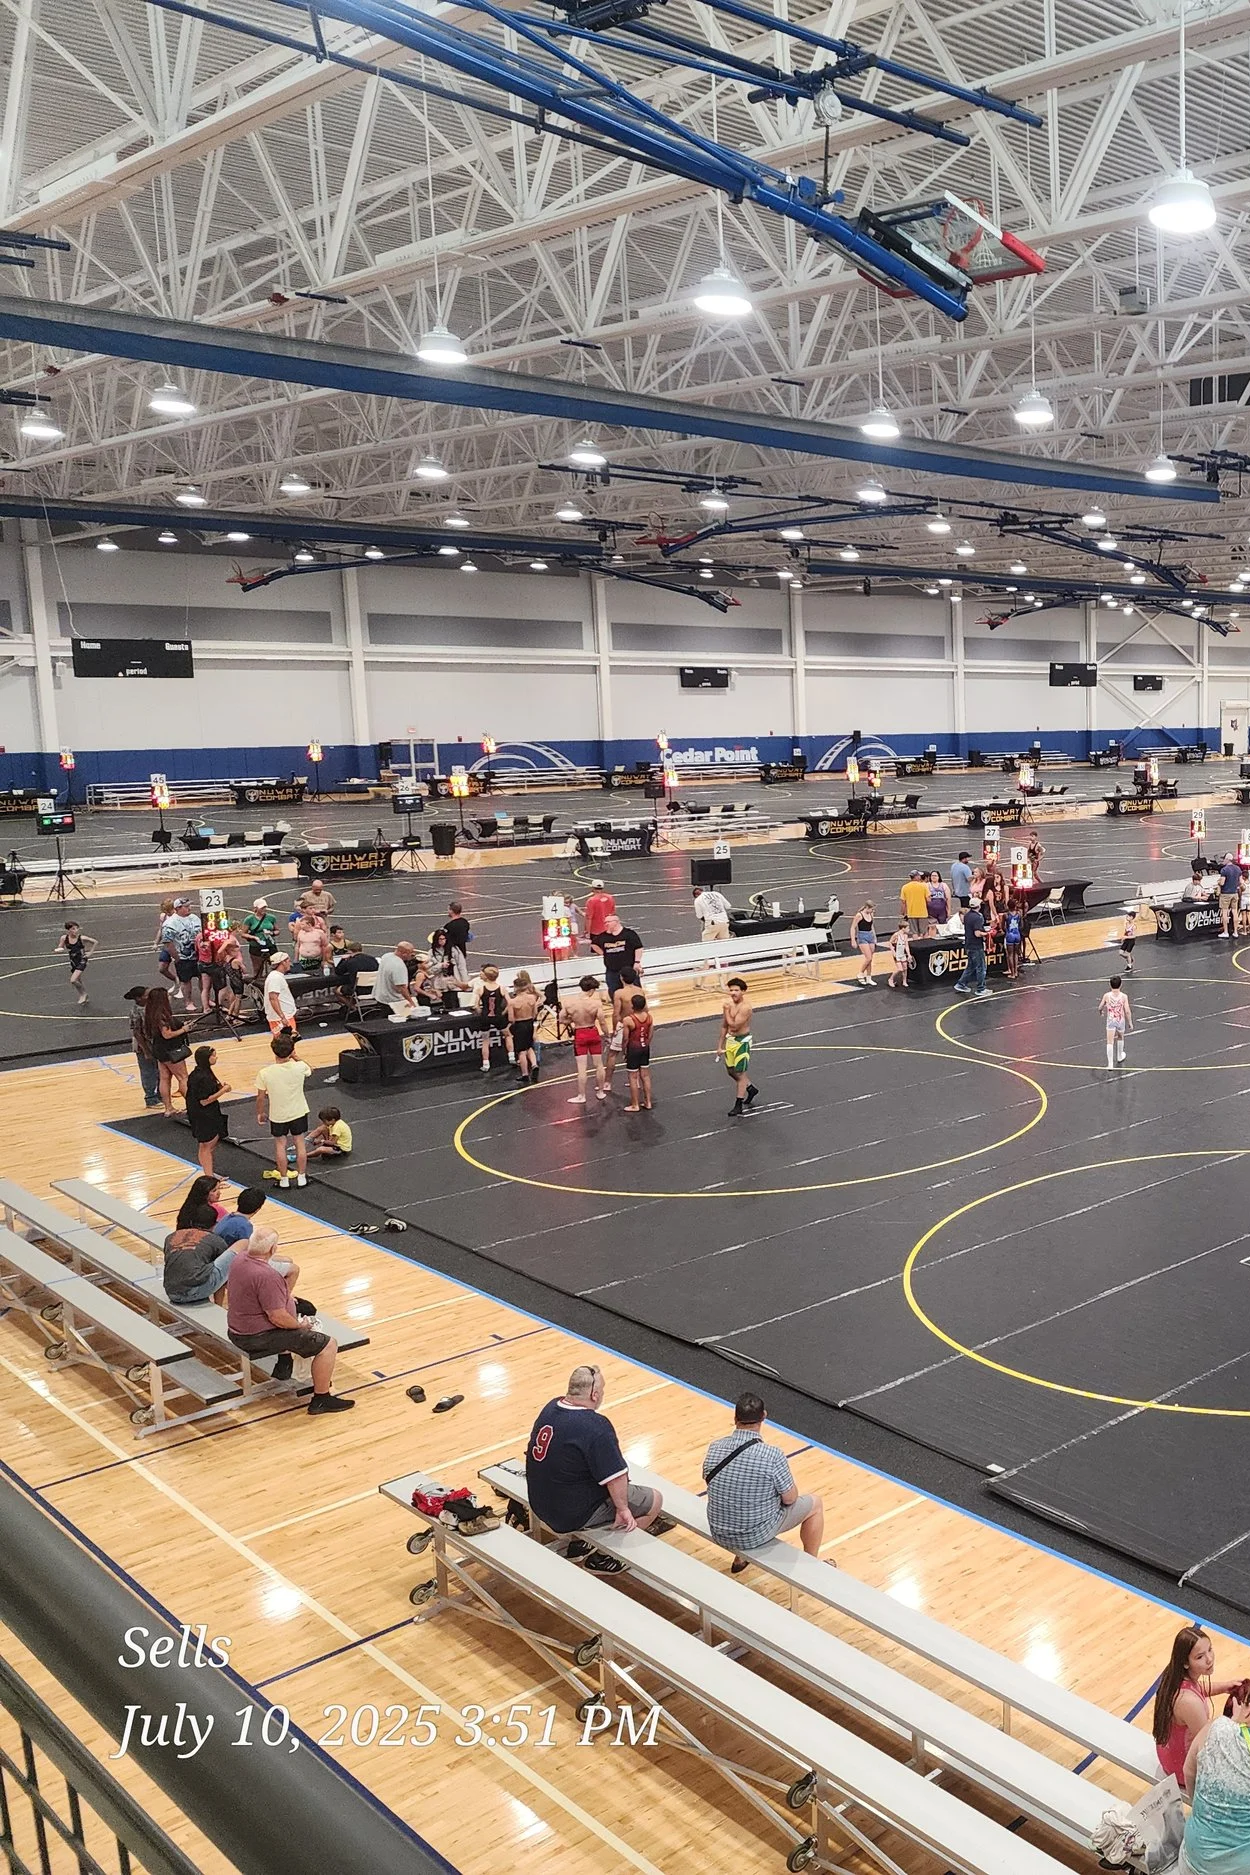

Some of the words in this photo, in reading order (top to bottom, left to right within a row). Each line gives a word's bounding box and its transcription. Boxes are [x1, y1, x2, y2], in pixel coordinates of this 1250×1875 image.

[660, 747, 712, 763] Cedar
[714, 745, 758, 762] Point
[152, 776, 164, 784] 45
[41, 803, 52, 811] 24
[990, 814, 1020, 823] COMBAT
[1193, 811, 1203, 819] 29
[830, 817, 865, 826] NUWAY
[830, 824, 865, 833] COMBAT
[606, 838, 641, 846] NUWAY
[606, 844, 641, 852] COMBAT
[715, 846, 728, 854] 25
[330, 851, 388, 863] NUWAY
[1016, 851, 1022, 860] 6
[330, 859, 387, 871] COMBAT
[205, 895, 221, 907] 23
[551, 903, 558, 914] 4
[434, 1026, 501, 1048] NUWA
[434, 1037, 503, 1056] COMBA
[532, 1424, 554, 1462] 9
